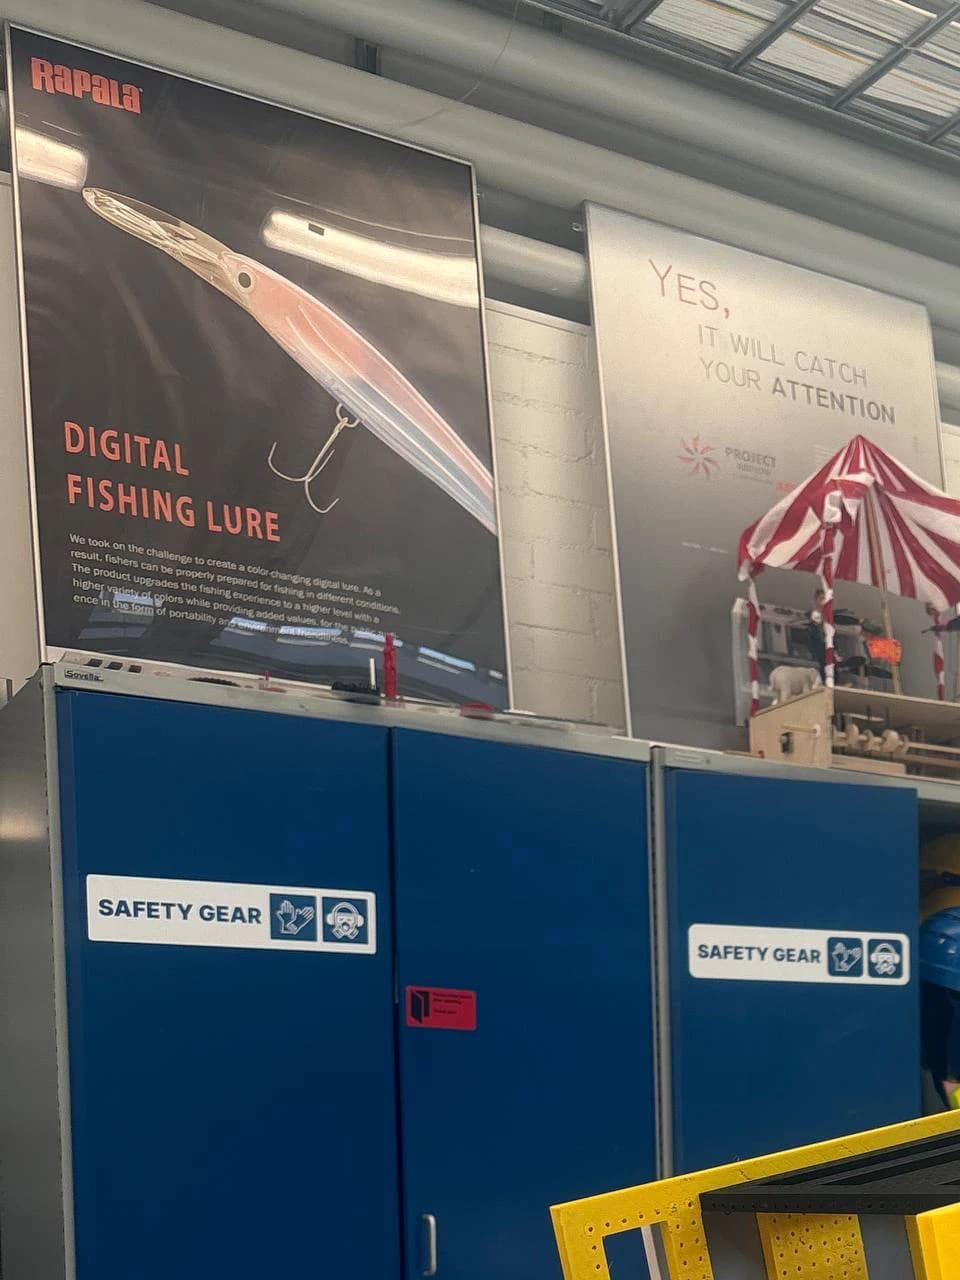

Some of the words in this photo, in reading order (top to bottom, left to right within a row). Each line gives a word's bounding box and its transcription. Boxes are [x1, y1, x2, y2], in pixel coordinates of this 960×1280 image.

[648, 258, 730, 319] YES,
[698, 323, 718, 347] IT
[730, 332, 785, 366] WILL
[794, 351, 868, 387] CATCH
[700, 357, 762, 391] YOUR
[771, 377, 896, 424] ATTENTION
[64, 421, 190, 476] DIGITAL
[67, 473, 195, 527] FISHING
[206, 501, 281, 542] LURE
[69, 533, 86, 545] We
[88, 537, 111, 548] took
[113, 542, 126, 551] on
[128, 543, 145, 554] the
[146, 546, 193, 564] challenge
[195, 556, 205, 565] to
[207, 559, 236, 570] create
[238, 564, 246, 572] a
[247, 565, 312, 587] color-changing
[313, 577, 340, 589] digital
[342, 580, 361, 593] lure.
[363, 586, 374, 596] As
[375, 589, 382, 597] a
[72, 563, 91, 574] The
[93, 567, 131, 582] product
[133, 575, 179, 590] upgrades
[181, 581, 197, 592] the
[199, 584, 231, 599] fishing
[232, 591, 281, 607] experience
[283, 600, 293, 609] to
[302, 603, 331, 615] higher
[333, 608, 353, 618] level
[354, 612, 373, 623] with
[105, 553, 139, 568] fishers
[140, 562, 159, 571] can
[161, 564, 173, 574] be
[175, 567, 215, 582] properly
[216, 573, 258, 590] prepared
[259, 581, 272, 591] for
[273, 583, 305, 599] fishing
[306, 590, 315, 598] in
[316, 591, 354, 606] different
[72, 578, 105, 592] higher
[107, 585, 139, 598] variety
[141, 590, 152, 599] of
[153, 592, 184, 604] colors
[185, 596, 211, 608] while
[212, 601, 255, 618] providing
[256, 609, 285, 621] added
[320, 618, 333, 628] for
[73, 594, 98, 606] ence
[101, 597, 111, 607] in
[112, 599, 130, 610] the
[131, 602, 154, 615] form
[156, 605, 166, 616] of
[169, 608, 217, 625] portability
[98, 898, 193, 921] SAFETY
[199, 904, 262, 925] GEAR
[697, 943, 769, 962] SAFETY
[773, 947, 821, 964] GEAR
